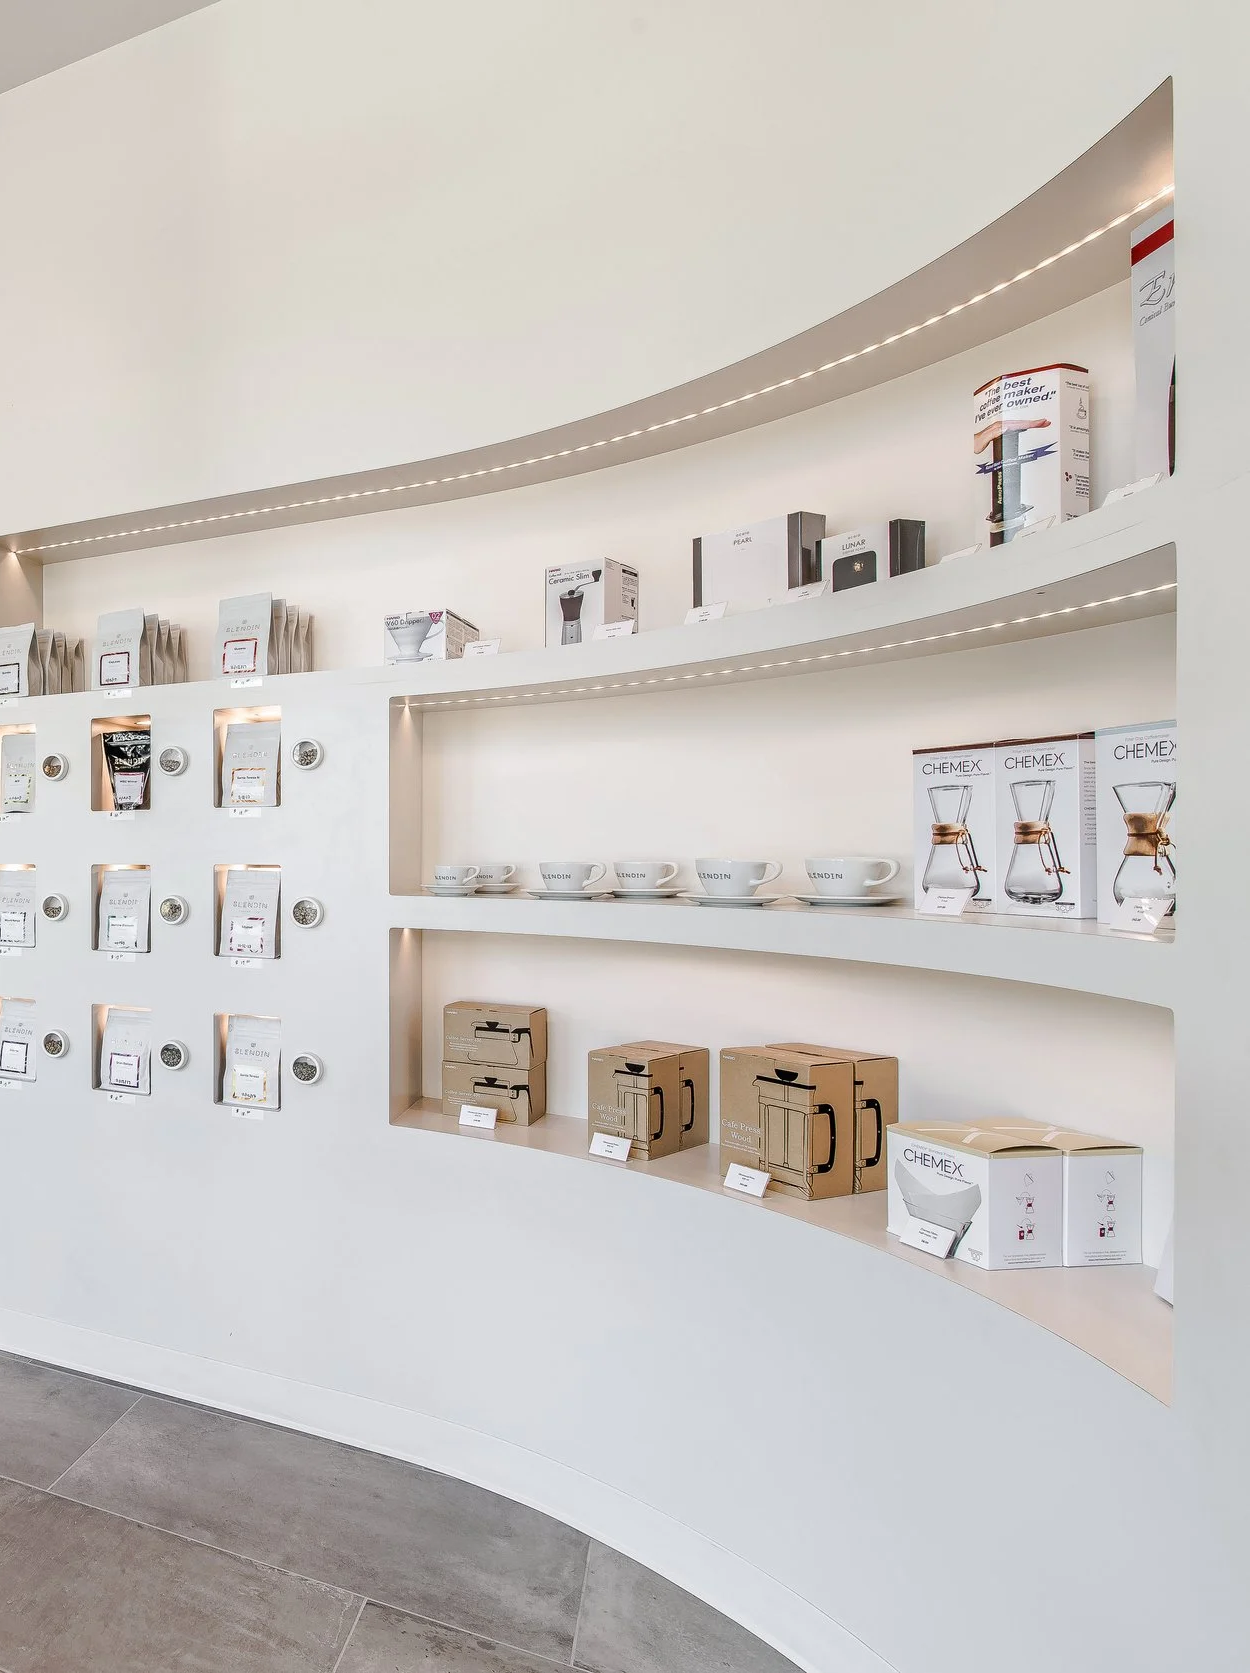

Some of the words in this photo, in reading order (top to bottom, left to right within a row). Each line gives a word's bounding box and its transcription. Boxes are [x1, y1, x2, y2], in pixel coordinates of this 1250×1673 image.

[1003, 377, 1032, 391] best
[979, 395, 1001, 412] coffee
[1003, 385, 1045, 400] maker
[974, 411, 986, 424] I've
[986, 402, 1003, 417] ever
[733, 536, 753, 547] PEARL
[841, 538, 866, 551] LUNAR
[548, 576, 575, 585] Ceramic
[575, 573, 590, 581] Slim
[385, 619, 399, 627] V60
[399, 617, 425, 627] Dripper
[431, 612, 441, 620] 02
[225, 623, 261, 633] BLENDIN
[1004, 752, 1066, 770] CHEMEX
[922, 759, 983, 776] CHEMEX
[232, 900, 269, 909] BLENDIN
[4, 1026, 33, 1035] BLENDIN
[234, 1047, 270, 1058] BLENDIN
[591, 1102, 607, 1112] Cafe
[608, 1105, 627, 1115] Press
[599, 1112, 618, 1123] Wood
[721, 1118, 738, 1130] Cafe
[739, 1120, 761, 1135] Press
[730, 1131, 751, 1143] Wood
[903, 1148, 964, 1178] CHEMEX
